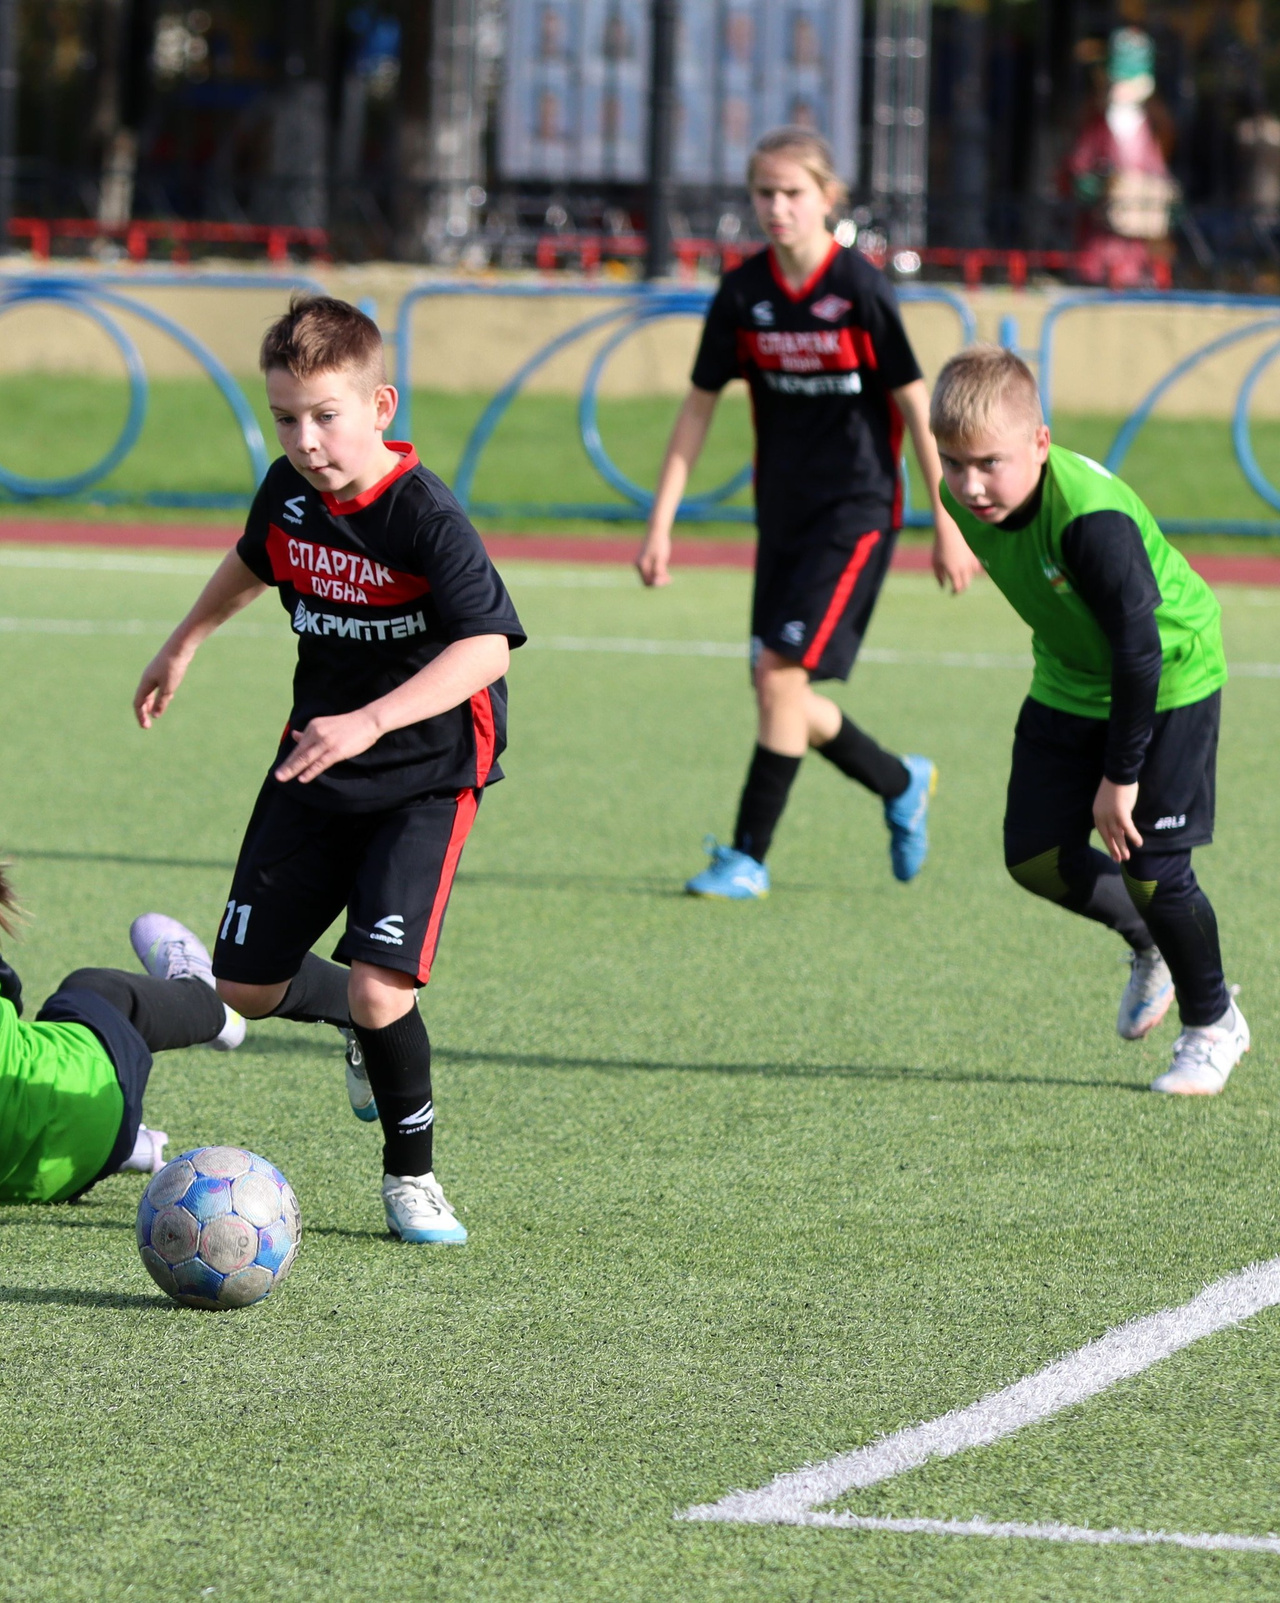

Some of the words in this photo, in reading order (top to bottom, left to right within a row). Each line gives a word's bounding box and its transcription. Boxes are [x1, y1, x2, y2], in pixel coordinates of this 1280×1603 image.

[288, 539, 395, 587] СПАРТАК
[311, 576, 369, 604] ДУБНА
[306, 610, 427, 641] КРИПТЕН
[220, 900, 252, 946] 11
